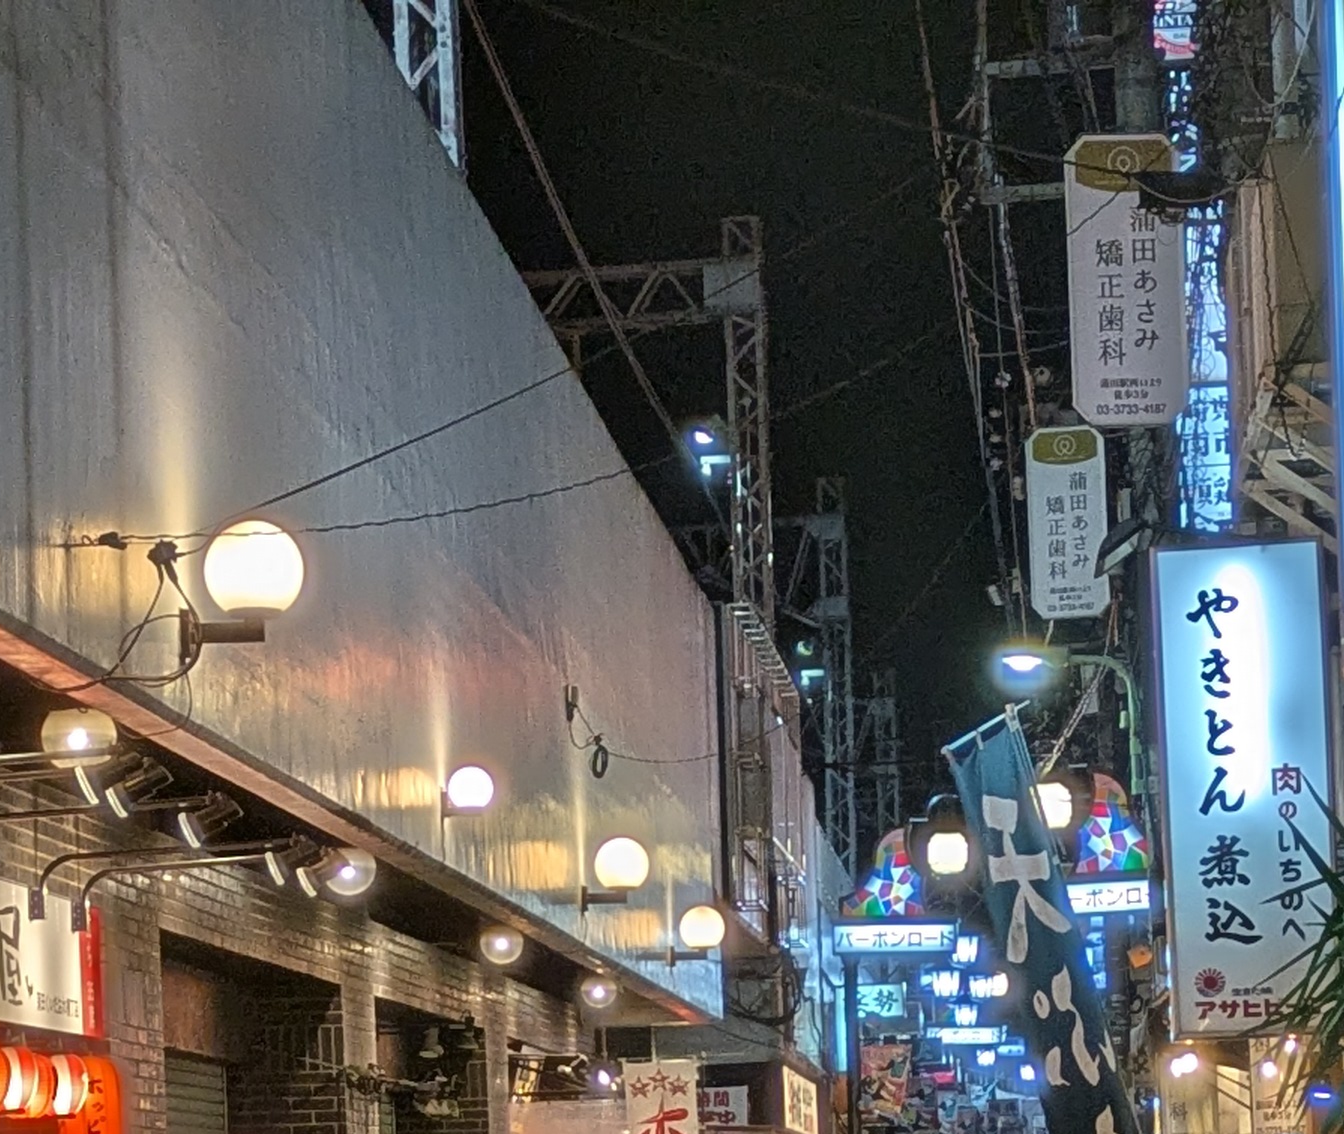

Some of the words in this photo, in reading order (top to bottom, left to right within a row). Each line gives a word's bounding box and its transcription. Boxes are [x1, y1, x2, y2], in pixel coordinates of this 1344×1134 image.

[1095, 239, 1127, 366] 矯正歯科
[1129, 206, 1159, 351] 蒲田あさみ
[1045, 496, 1068, 580] 矯正歯科
[1069, 471, 1090, 569] 蒲田あさみ
[1185, 588, 1246, 816] やきとん
[836, 930, 955, 949] バーボンロード
